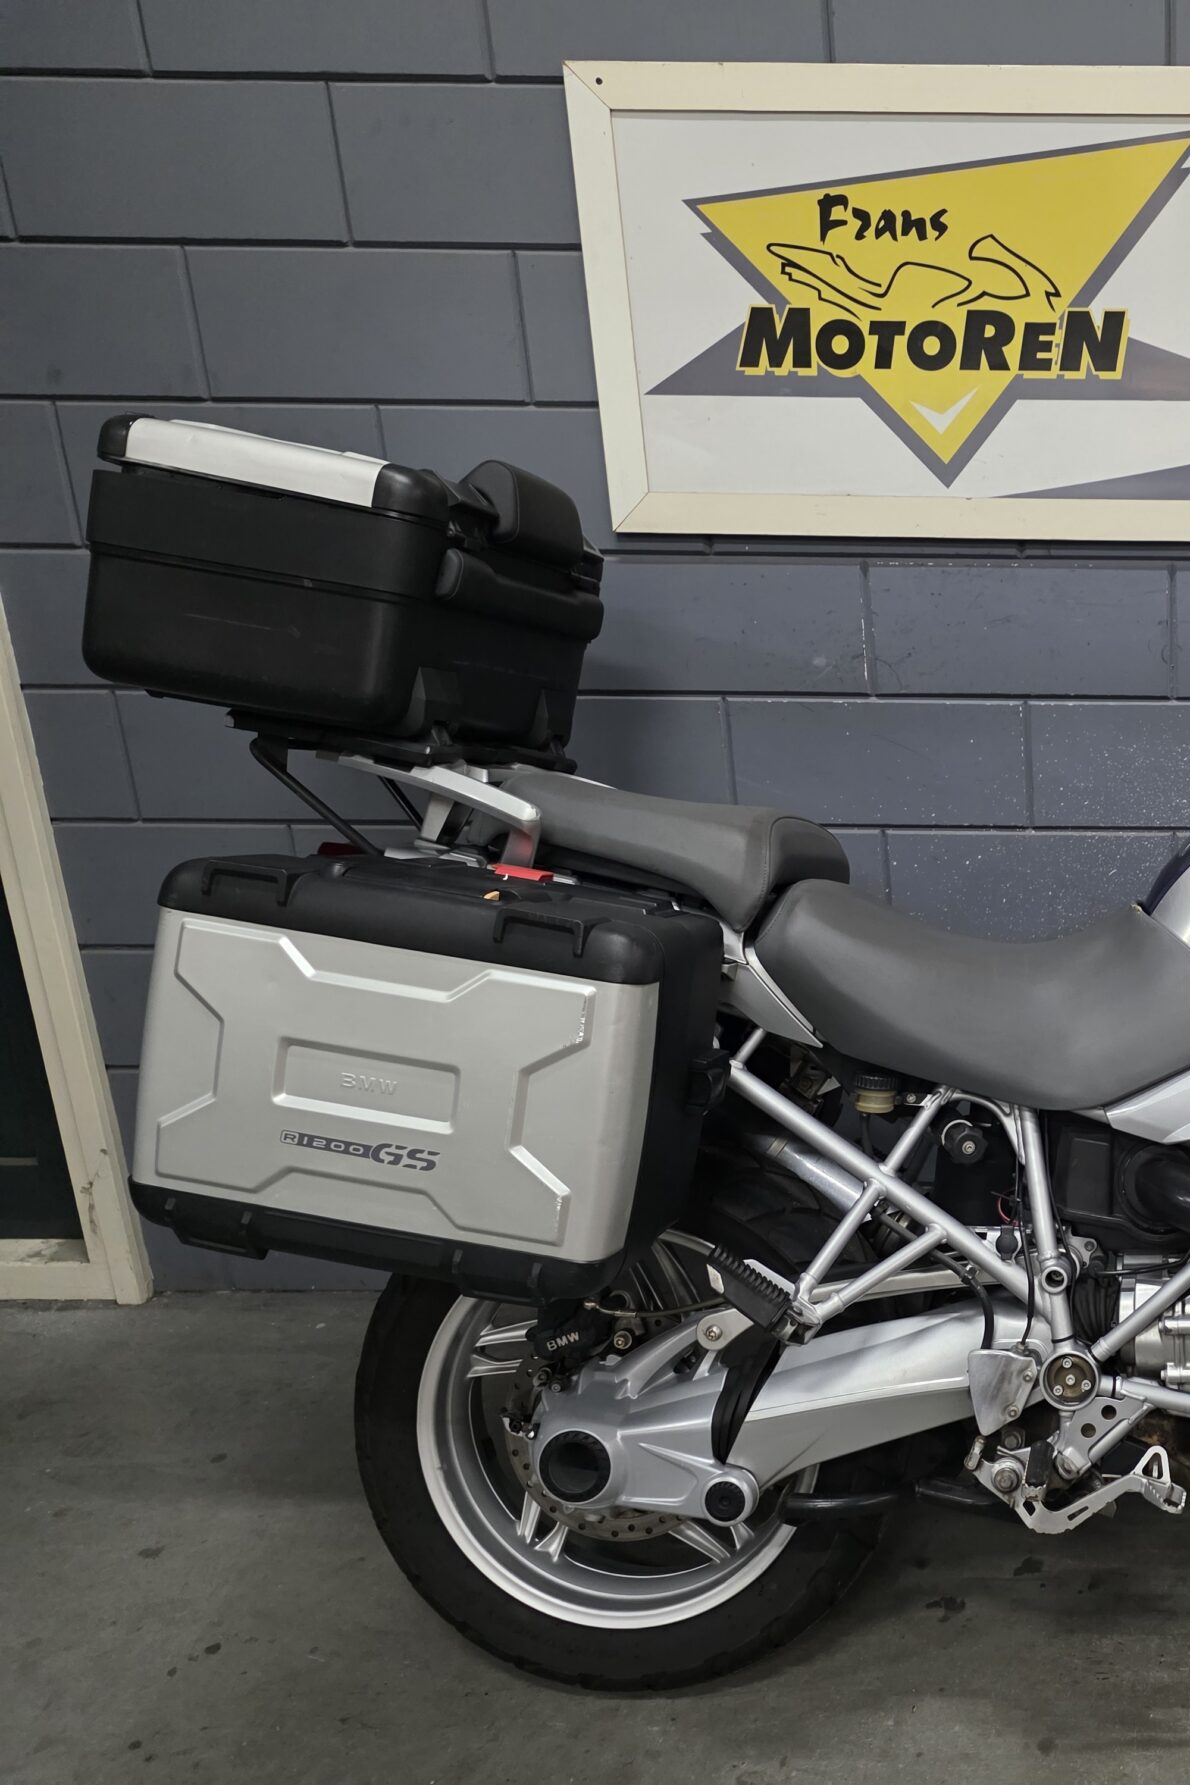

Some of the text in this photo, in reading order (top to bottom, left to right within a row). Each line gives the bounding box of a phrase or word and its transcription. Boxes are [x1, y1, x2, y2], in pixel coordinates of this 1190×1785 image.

[816, 193, 949, 245] Frans
[340, 1072, 398, 1095] BMW
[546, 1331, 579, 1351] BMW
